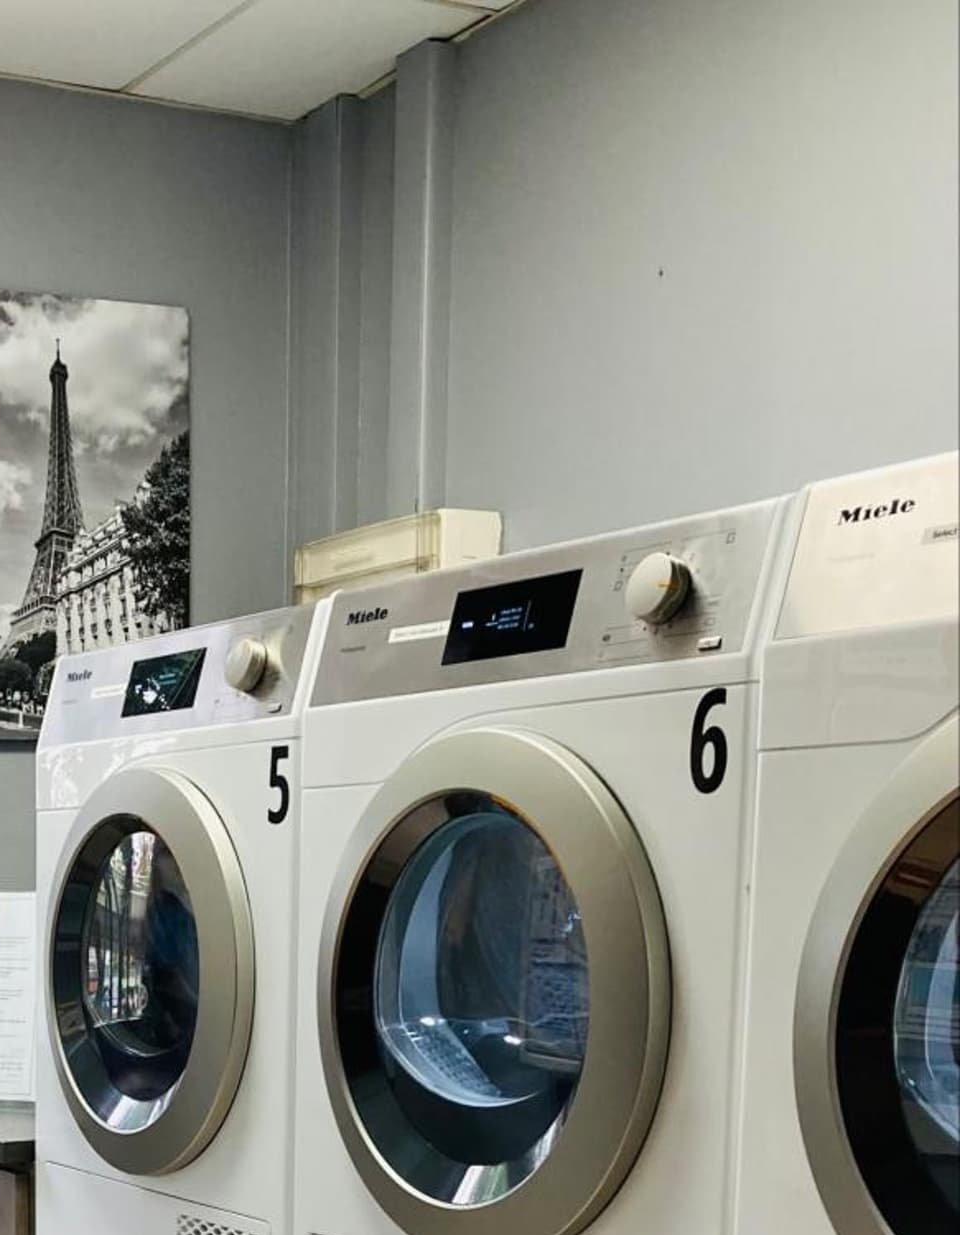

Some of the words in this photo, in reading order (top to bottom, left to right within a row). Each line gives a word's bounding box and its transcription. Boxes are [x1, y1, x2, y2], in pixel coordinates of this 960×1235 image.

[837, 499, 916, 526] Miele
[345, 607, 388, 626] Miele
[690, 687, 728, 794] 6
[267, 745, 290, 824] 5
